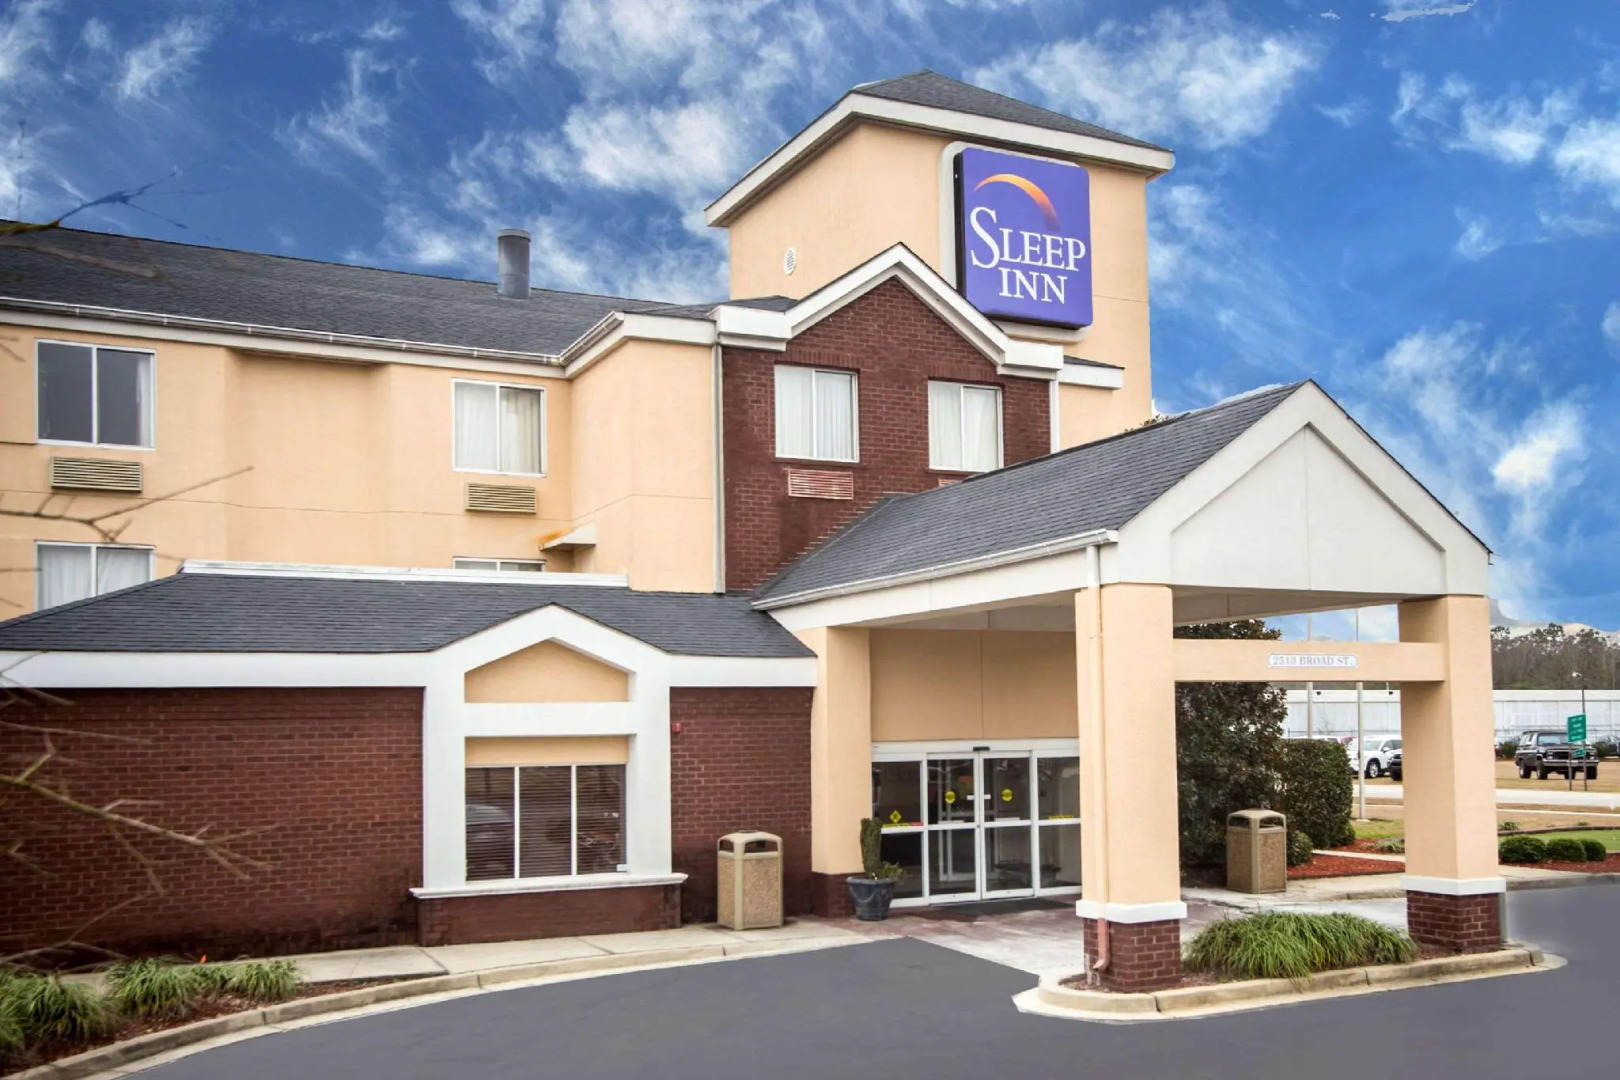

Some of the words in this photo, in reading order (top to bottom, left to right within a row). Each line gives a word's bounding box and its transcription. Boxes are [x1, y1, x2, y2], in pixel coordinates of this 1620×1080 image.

[970, 206, 1086, 271] SLEEP
[998, 267, 1068, 304] INN
[1299, 656, 1334, 666] BROAD
